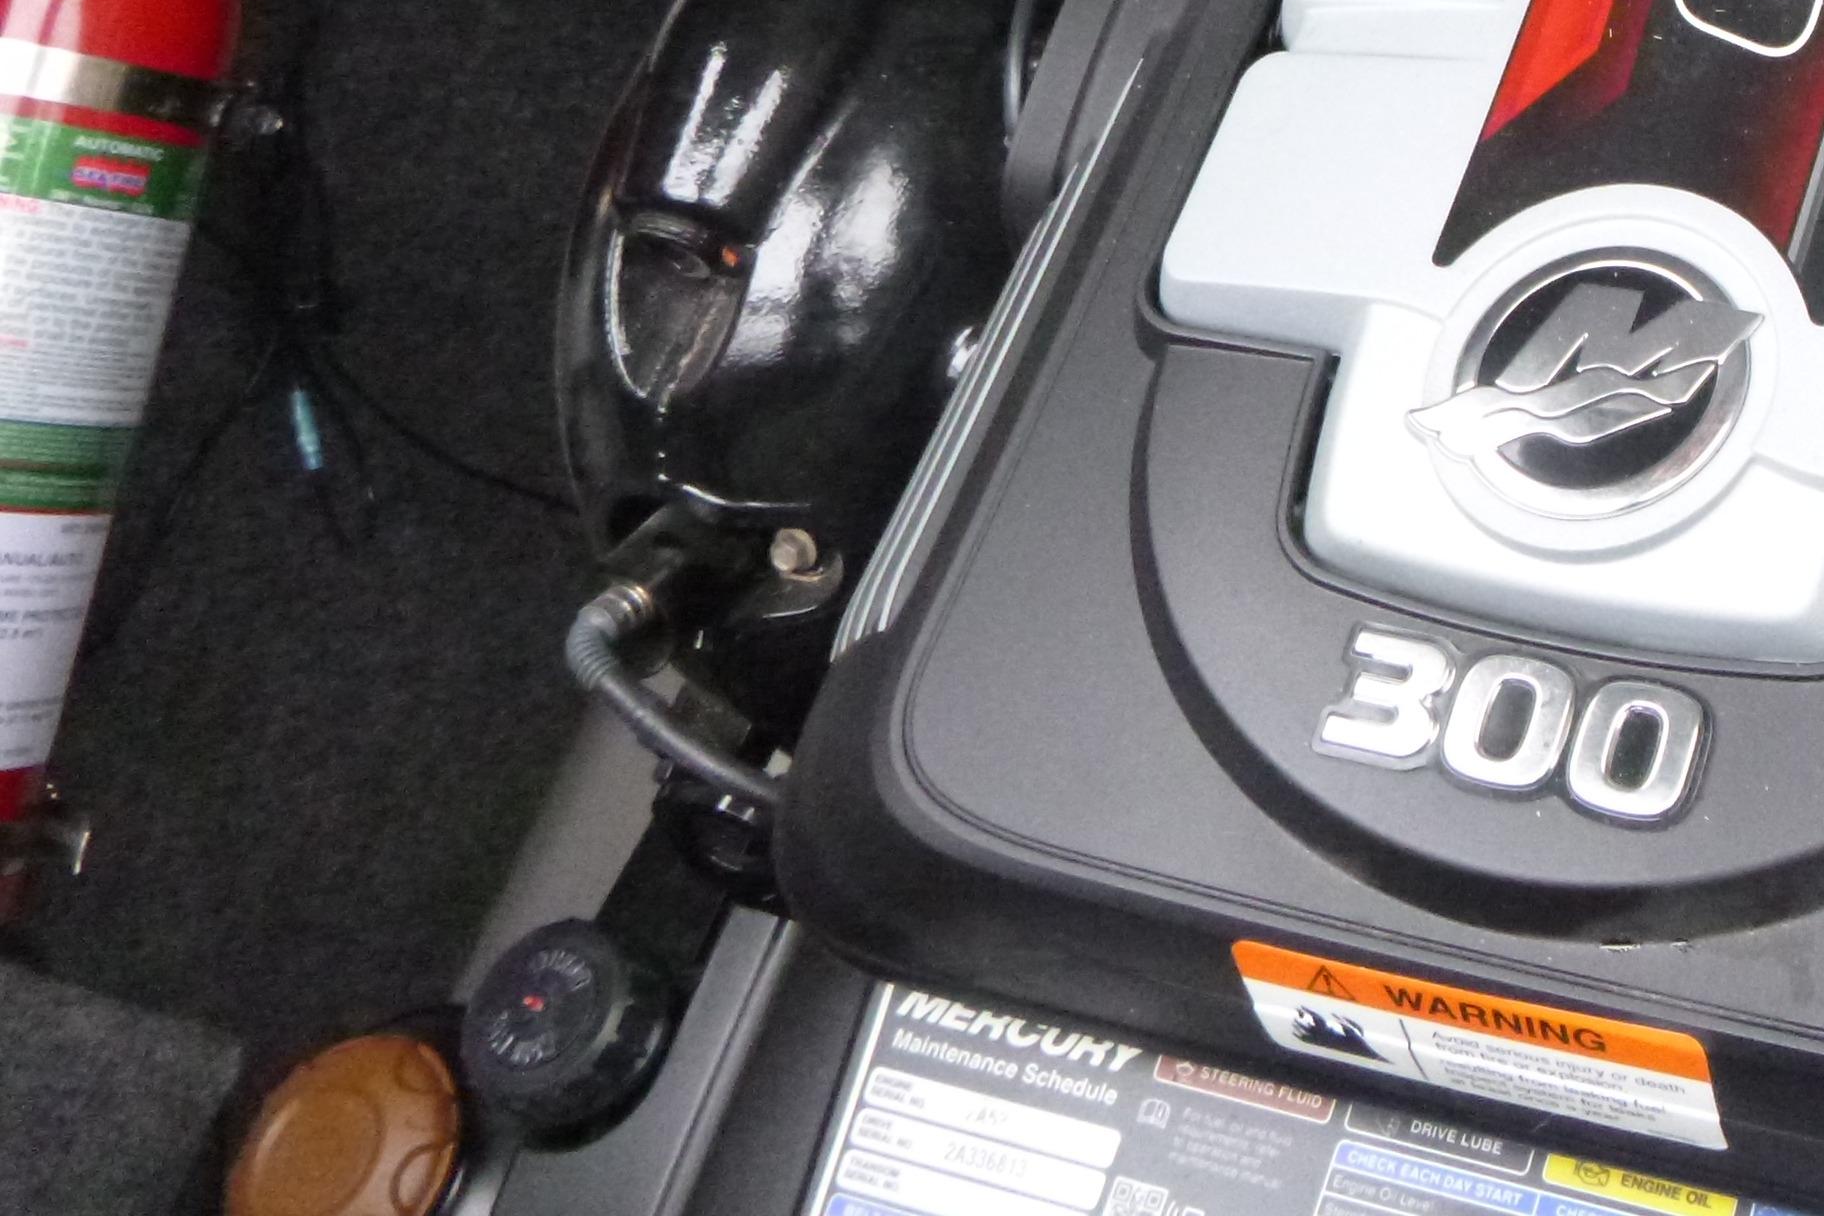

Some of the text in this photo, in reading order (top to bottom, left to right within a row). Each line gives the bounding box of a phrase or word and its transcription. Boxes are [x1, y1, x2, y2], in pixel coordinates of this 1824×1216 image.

[1312, 622, 1712, 828] 300
[895, 991, 1143, 1072] MERCURY
[1384, 983, 1607, 1053] WARNING
[891, 1027, 1119, 1107] Maintenance Schedule
[1199, 1065, 1323, 1110] STEERING FLUID
[1409, 1119, 1504, 1155] DRIVE LUBE
[1347, 1150, 1523, 1206] CHECK EACH DAY START
[1620, 1172, 1712, 1209] ENGINE OIL
